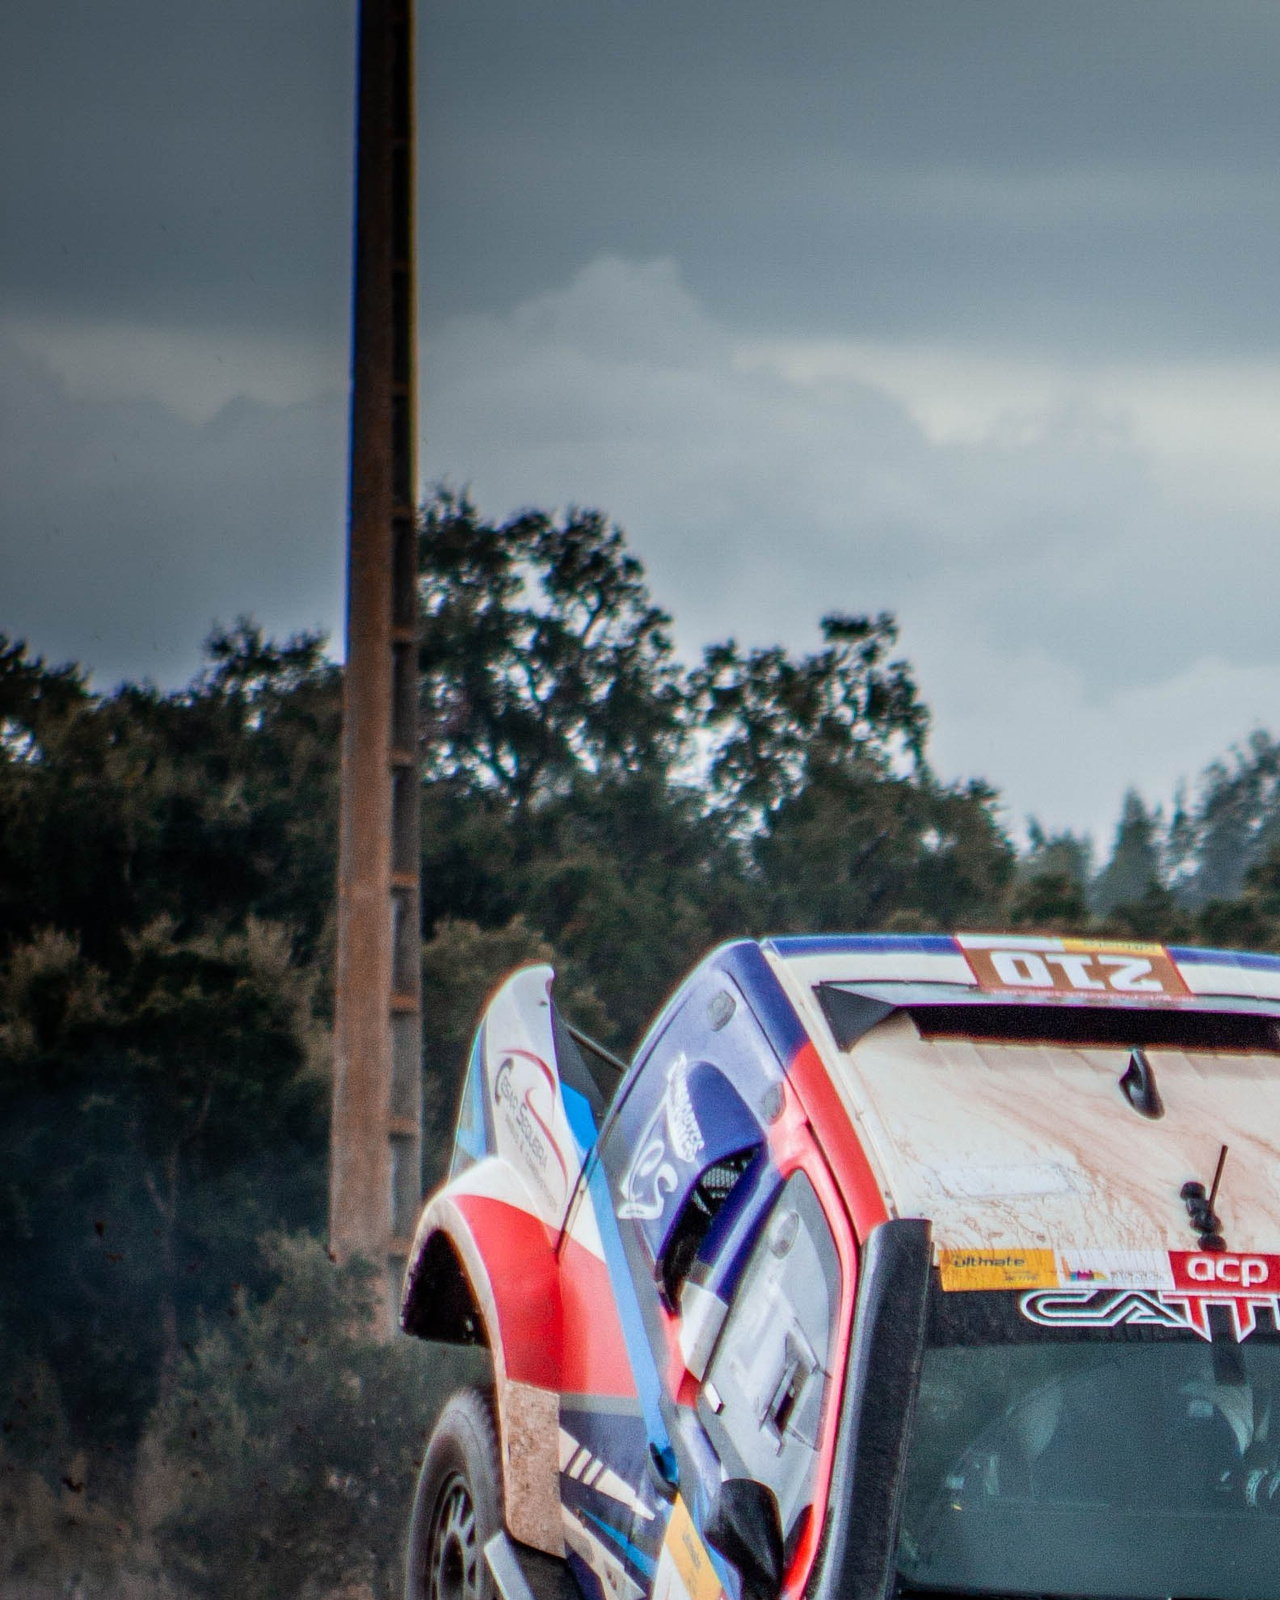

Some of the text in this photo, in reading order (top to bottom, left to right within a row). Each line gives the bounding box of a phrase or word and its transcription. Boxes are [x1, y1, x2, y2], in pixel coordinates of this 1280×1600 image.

[989, 951, 1164, 992] 210
[952, 1256, 1025, 1269] ultimate
[1187, 1256, 1269, 1288] acp
